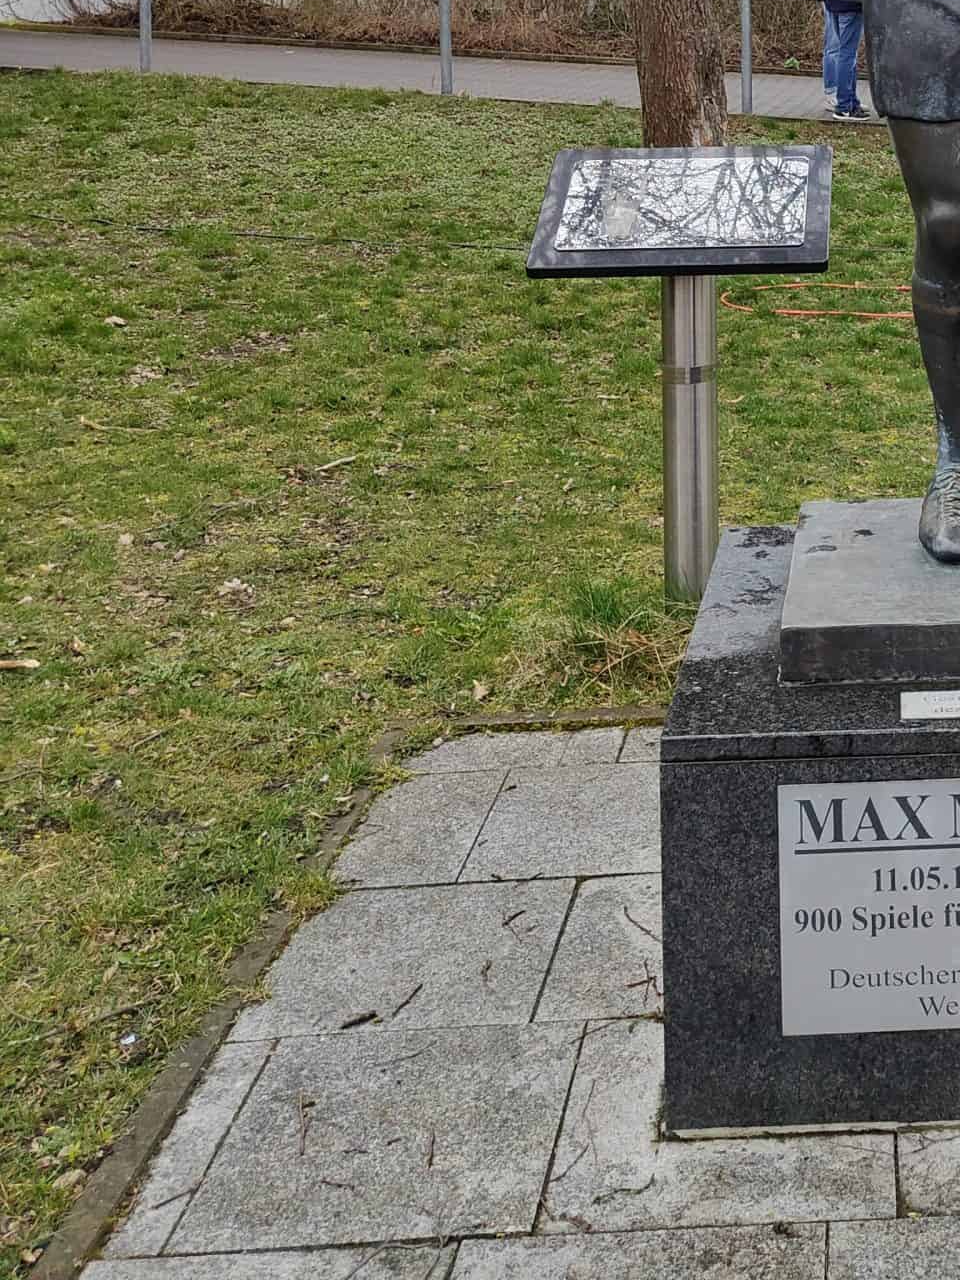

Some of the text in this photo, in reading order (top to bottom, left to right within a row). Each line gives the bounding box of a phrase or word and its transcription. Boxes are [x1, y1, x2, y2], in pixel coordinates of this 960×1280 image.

[794, 795, 933, 844] MAX
[794, 908, 842, 933] 900
[852, 904, 934, 937] Spiele
[829, 965, 960, 989] Deutscher
